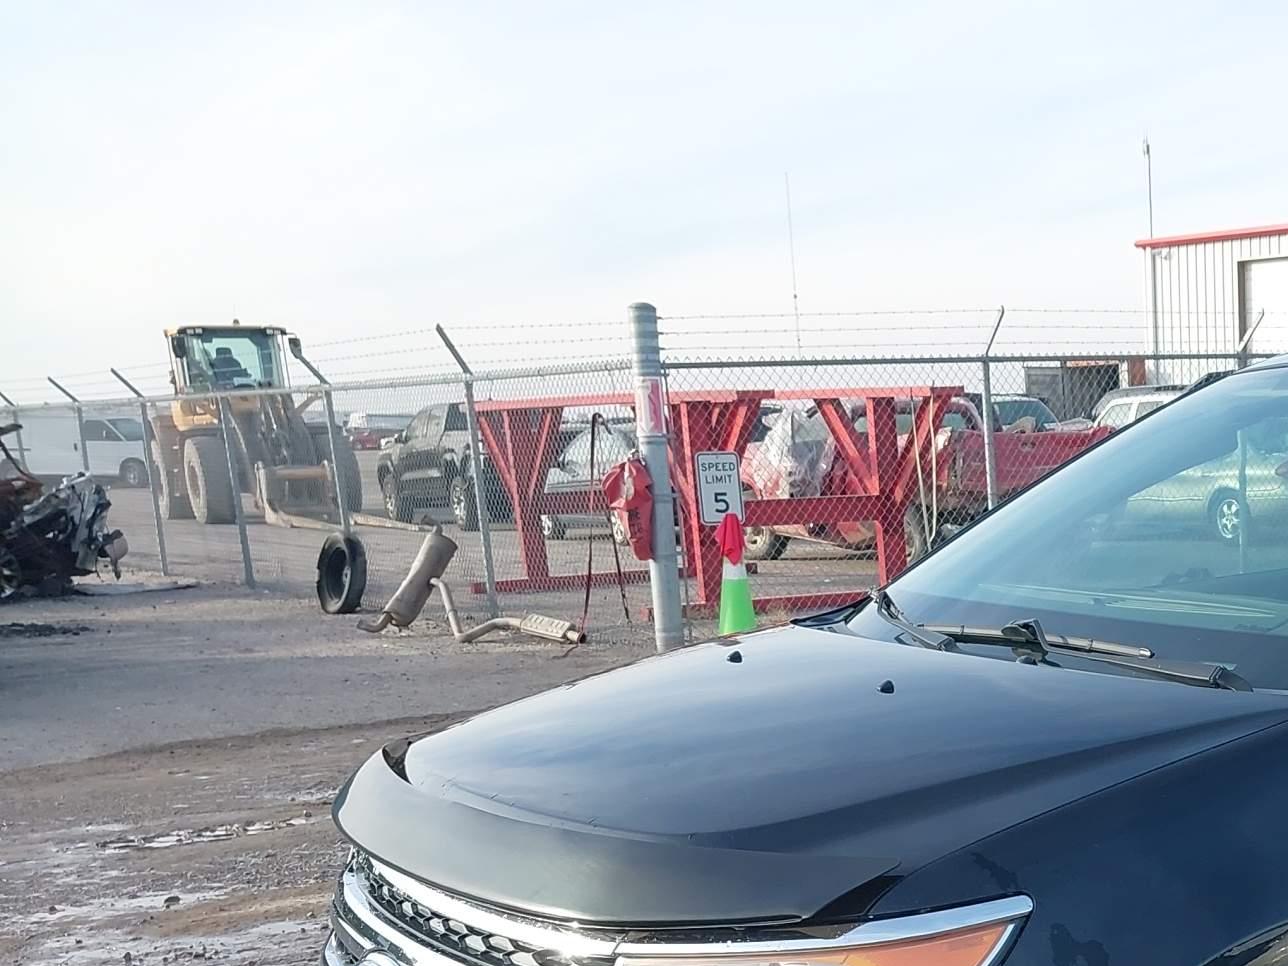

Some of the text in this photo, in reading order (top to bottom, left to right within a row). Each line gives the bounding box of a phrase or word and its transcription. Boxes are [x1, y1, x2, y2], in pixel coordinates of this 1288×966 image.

[701, 462, 736, 472] SPEED
[705, 474, 733, 485] LIMIT
[713, 491, 730, 514] 5
